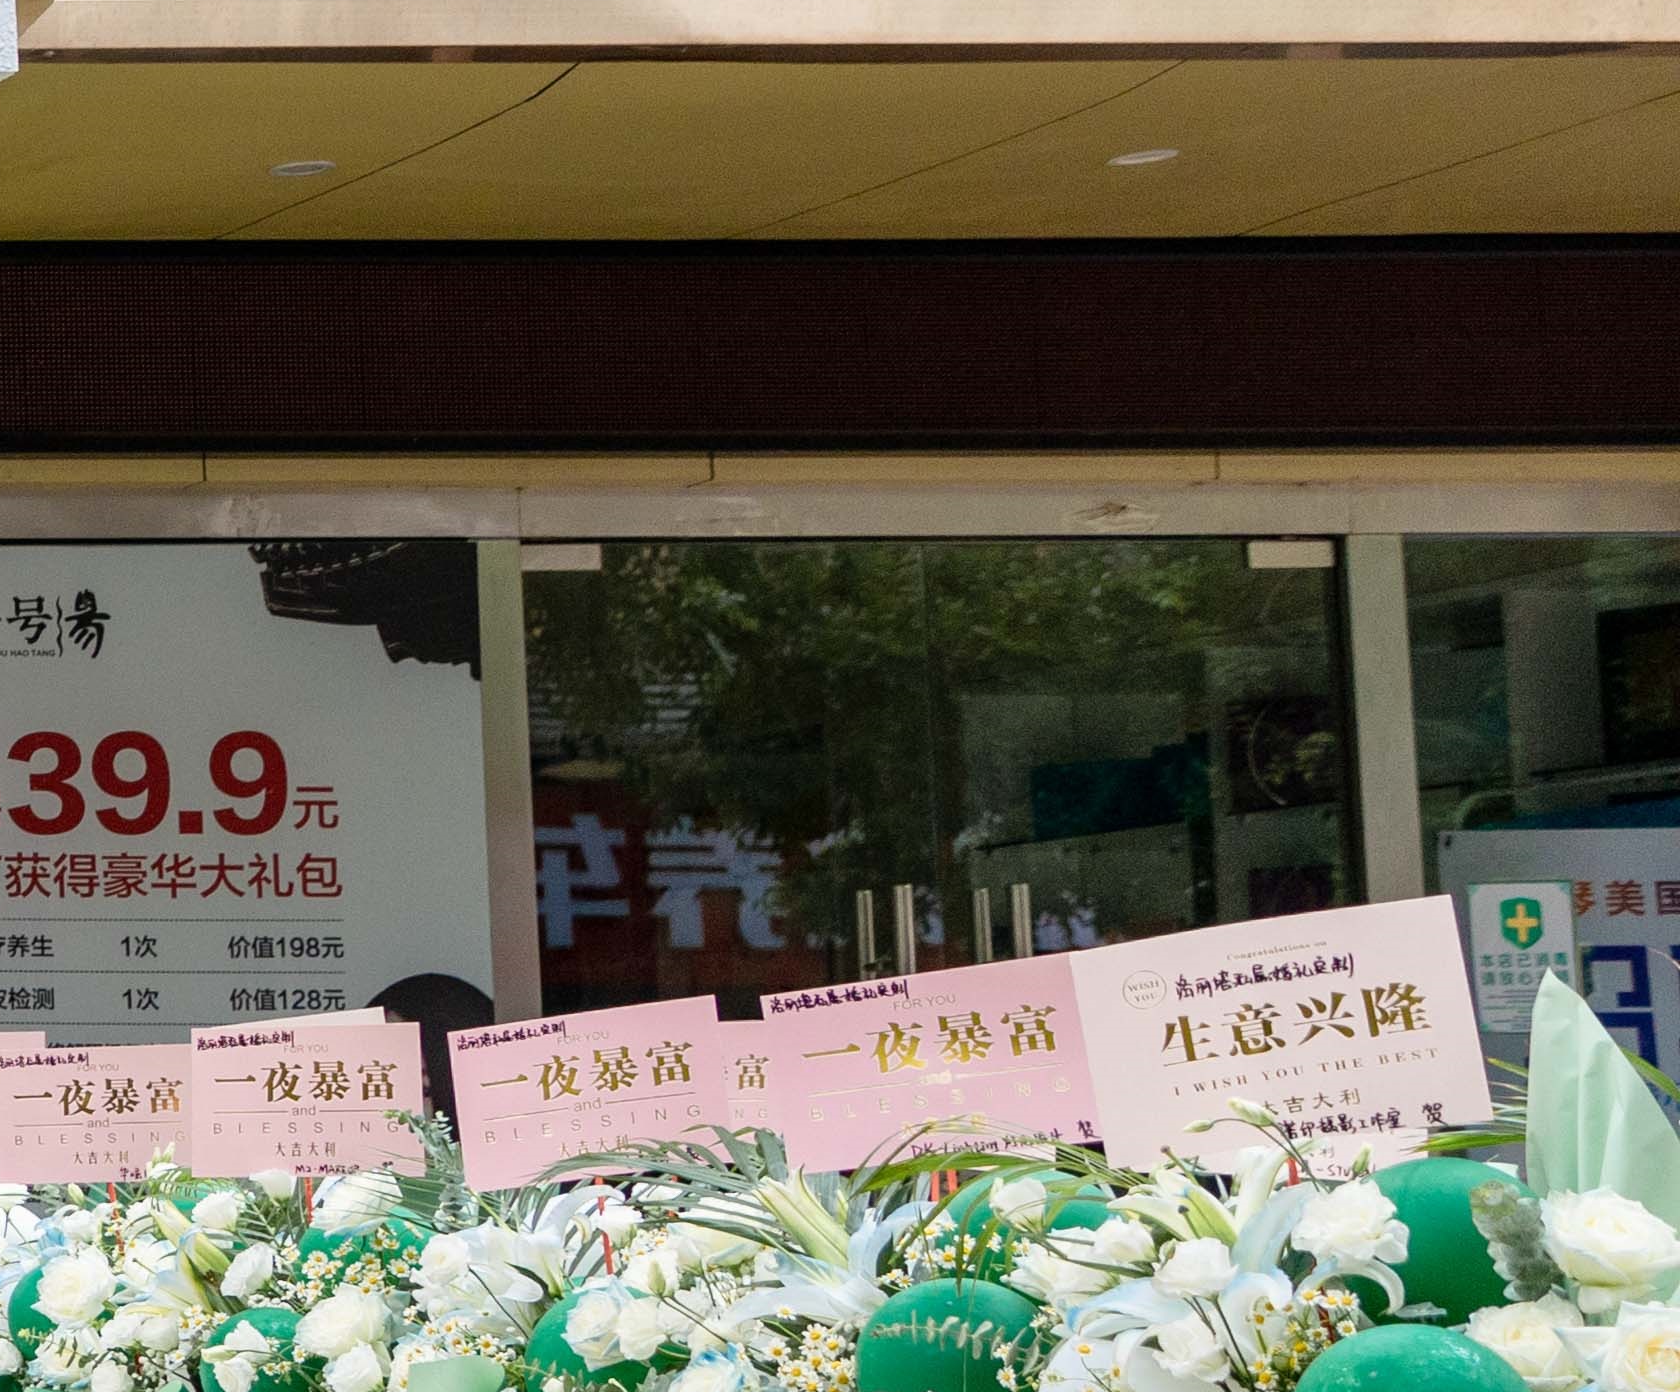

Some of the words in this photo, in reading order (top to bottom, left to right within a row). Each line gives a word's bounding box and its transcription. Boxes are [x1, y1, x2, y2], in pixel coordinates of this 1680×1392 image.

[120, 936, 158, 959] 1次
[227, 935, 345, 960] 价值198元
[122, 988, 160, 1012] 1次
[229, 987, 346, 1012] 价值128元
[802, 1004, 1057, 1074] 一夜暴富
[1161, 981, 1432, 1067] 生意兴隆
[214, 1060, 399, 1103] 一夜暴富
[480, 1040, 693, 1101] 一夜暴富
[1193, 1075, 1248, 1094] WISH
[1262, 1066, 1305, 1082] YOU
[1320, 1057, 1363, 1073] THE
[1378, 1048, 1439, 1066] BEST
[13, 1077, 184, 1116] 一夜暴富
[15, 1130, 185, 1146] BLESSING
[213, 1121, 398, 1135] BLESSING
[484, 1104, 701, 1145] BLESSING
